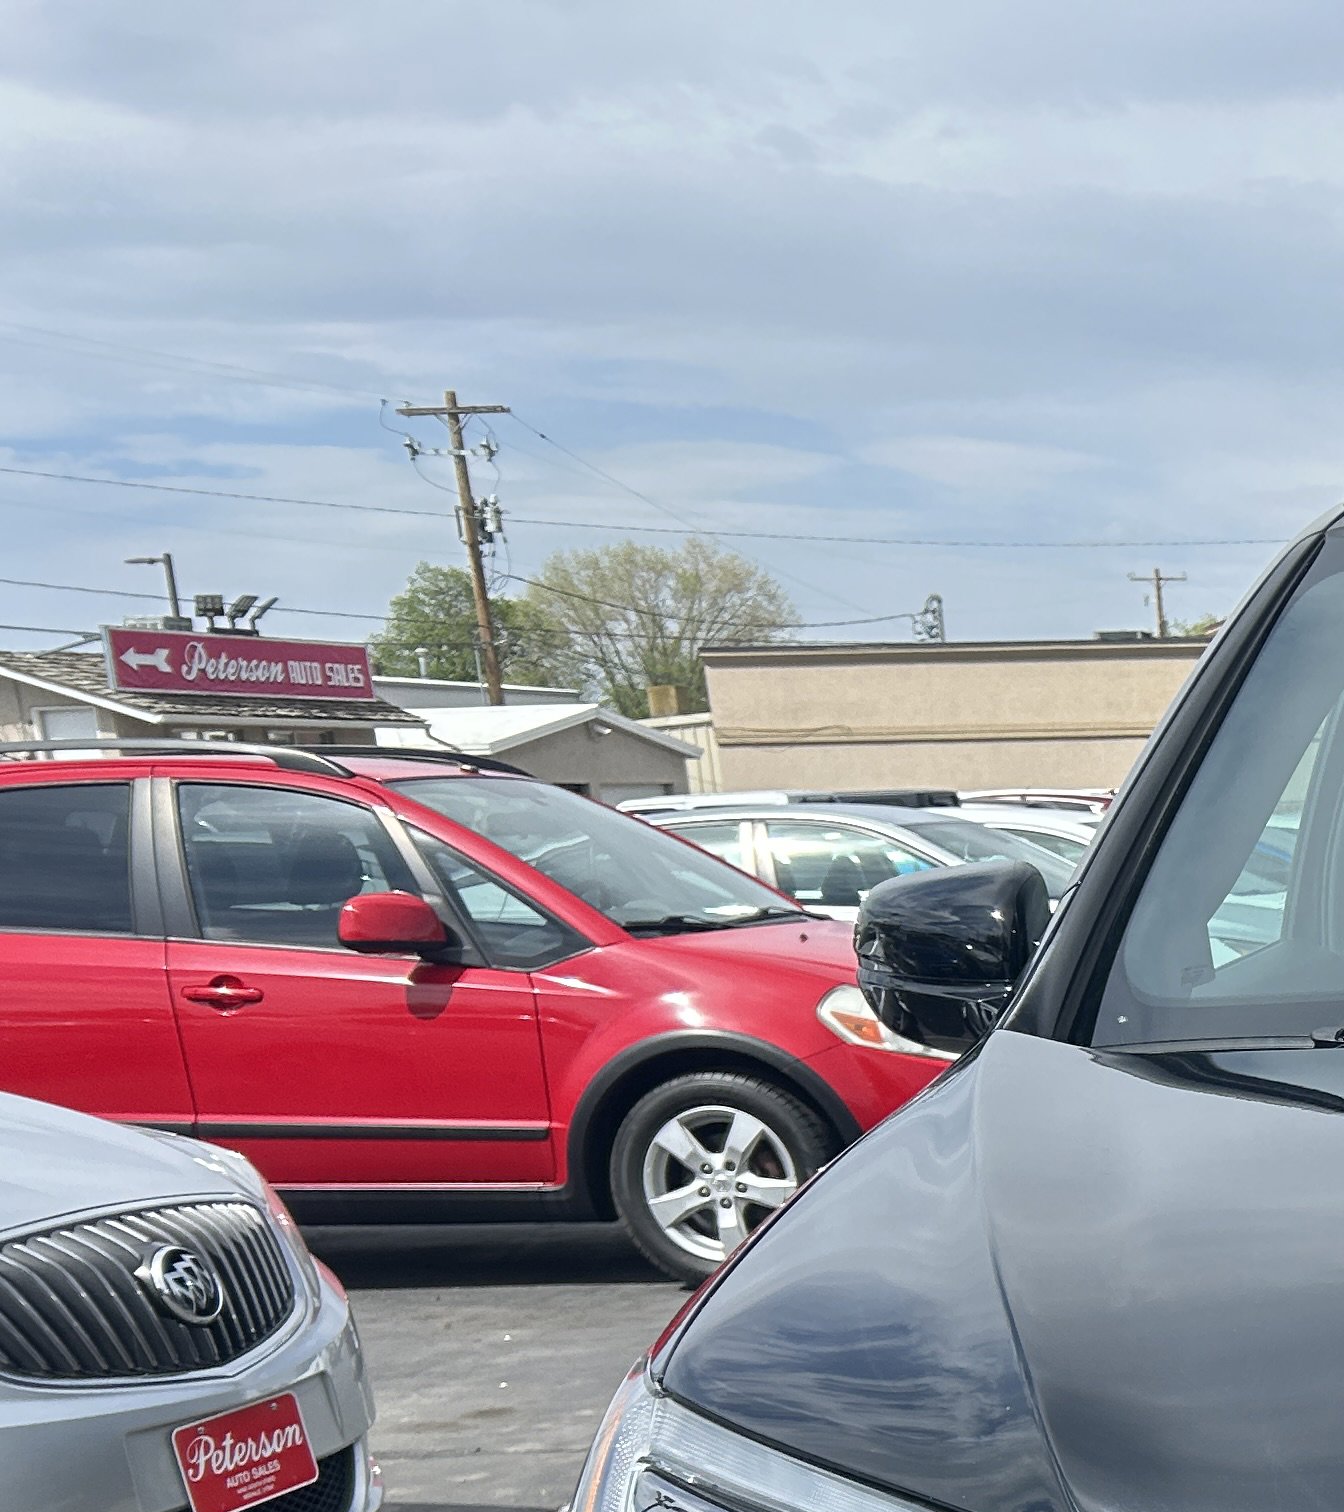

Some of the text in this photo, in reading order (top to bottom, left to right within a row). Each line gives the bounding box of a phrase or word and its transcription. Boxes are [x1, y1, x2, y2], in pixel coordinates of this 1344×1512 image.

[180, 641, 364, 688] Peterson AUTO SALES
[186, 1423, 303, 1482] Peterson
[226, 1470, 250, 1489] AUTO
[251, 1459, 281, 1479] SALES
